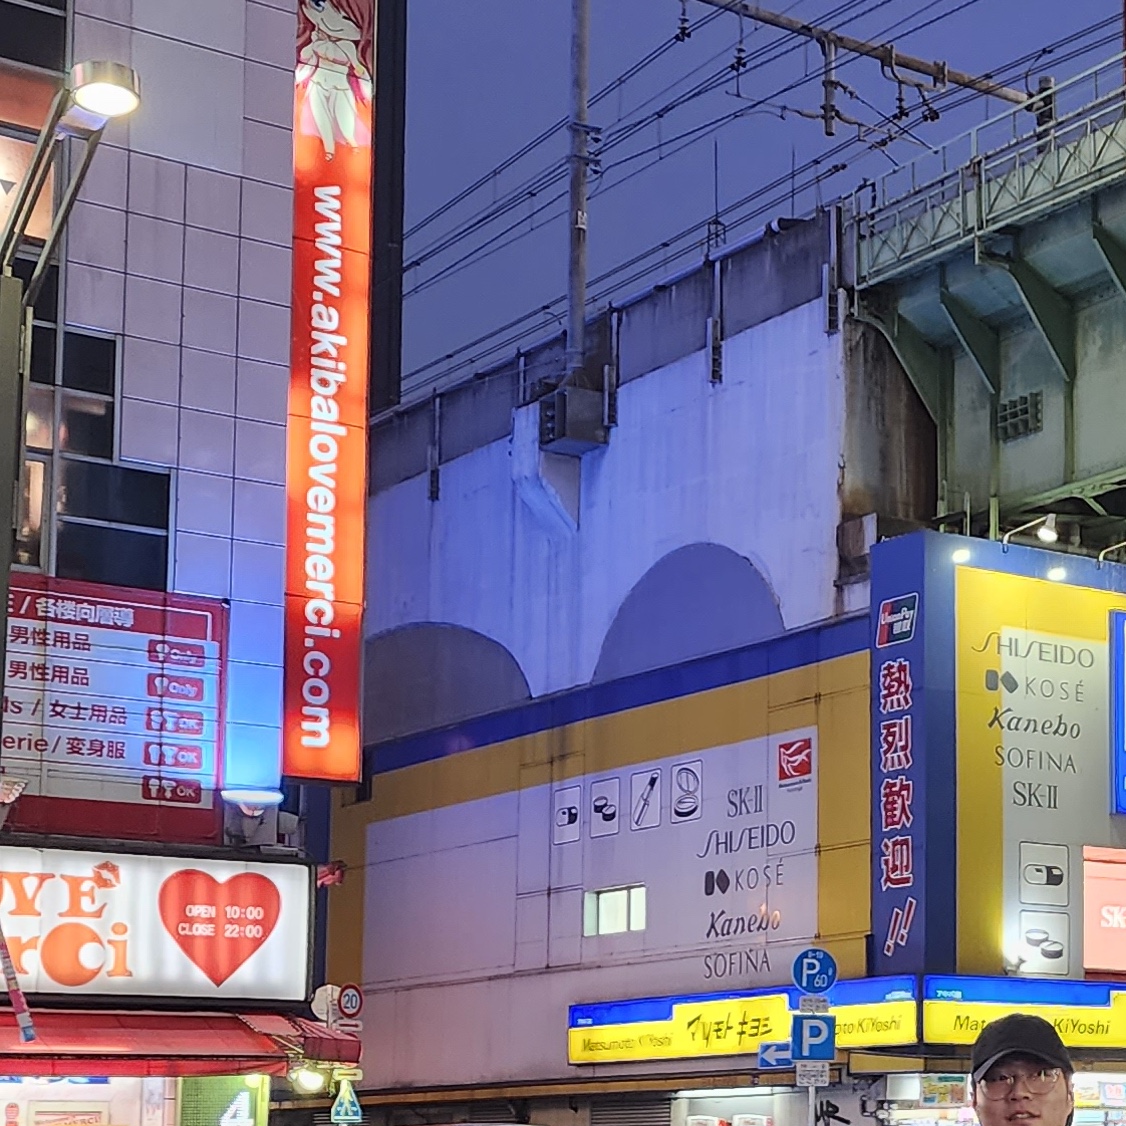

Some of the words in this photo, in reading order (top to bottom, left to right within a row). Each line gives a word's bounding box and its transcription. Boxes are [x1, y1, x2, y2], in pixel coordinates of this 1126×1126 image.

[300, 185, 347, 747] www.akibalovemerci.com
[8, 625, 91, 651] 男性用品
[971, 632, 1094, 668] SHISEIDO
[8, 661, 90, 686] 男性用品
[1025, 676, 1084, 702] KOSÉ
[49, 700, 128, 725] 女士用品
[988, 706, 1080, 739] Kanebo
[994, 745, 1077, 773] SOFINA
[696, 820, 795, 858] SHISEIDO
[735, 857, 784, 891] KOSÉ
[185, 904, 216, 918] OPEN
[224, 905, 264, 920] 10:00
[706, 902, 780, 938] Kanebo
[178, 922, 216, 936] CLOSE
[224, 924, 263, 938] 22:00
[704, 949, 771, 979] SOFINA
[802, 958, 821, 987] P
[343, 993, 358, 1009] 20
[802, 1019, 829, 1056] P
[1053, 1018, 1111, 1035] KiYoshi
